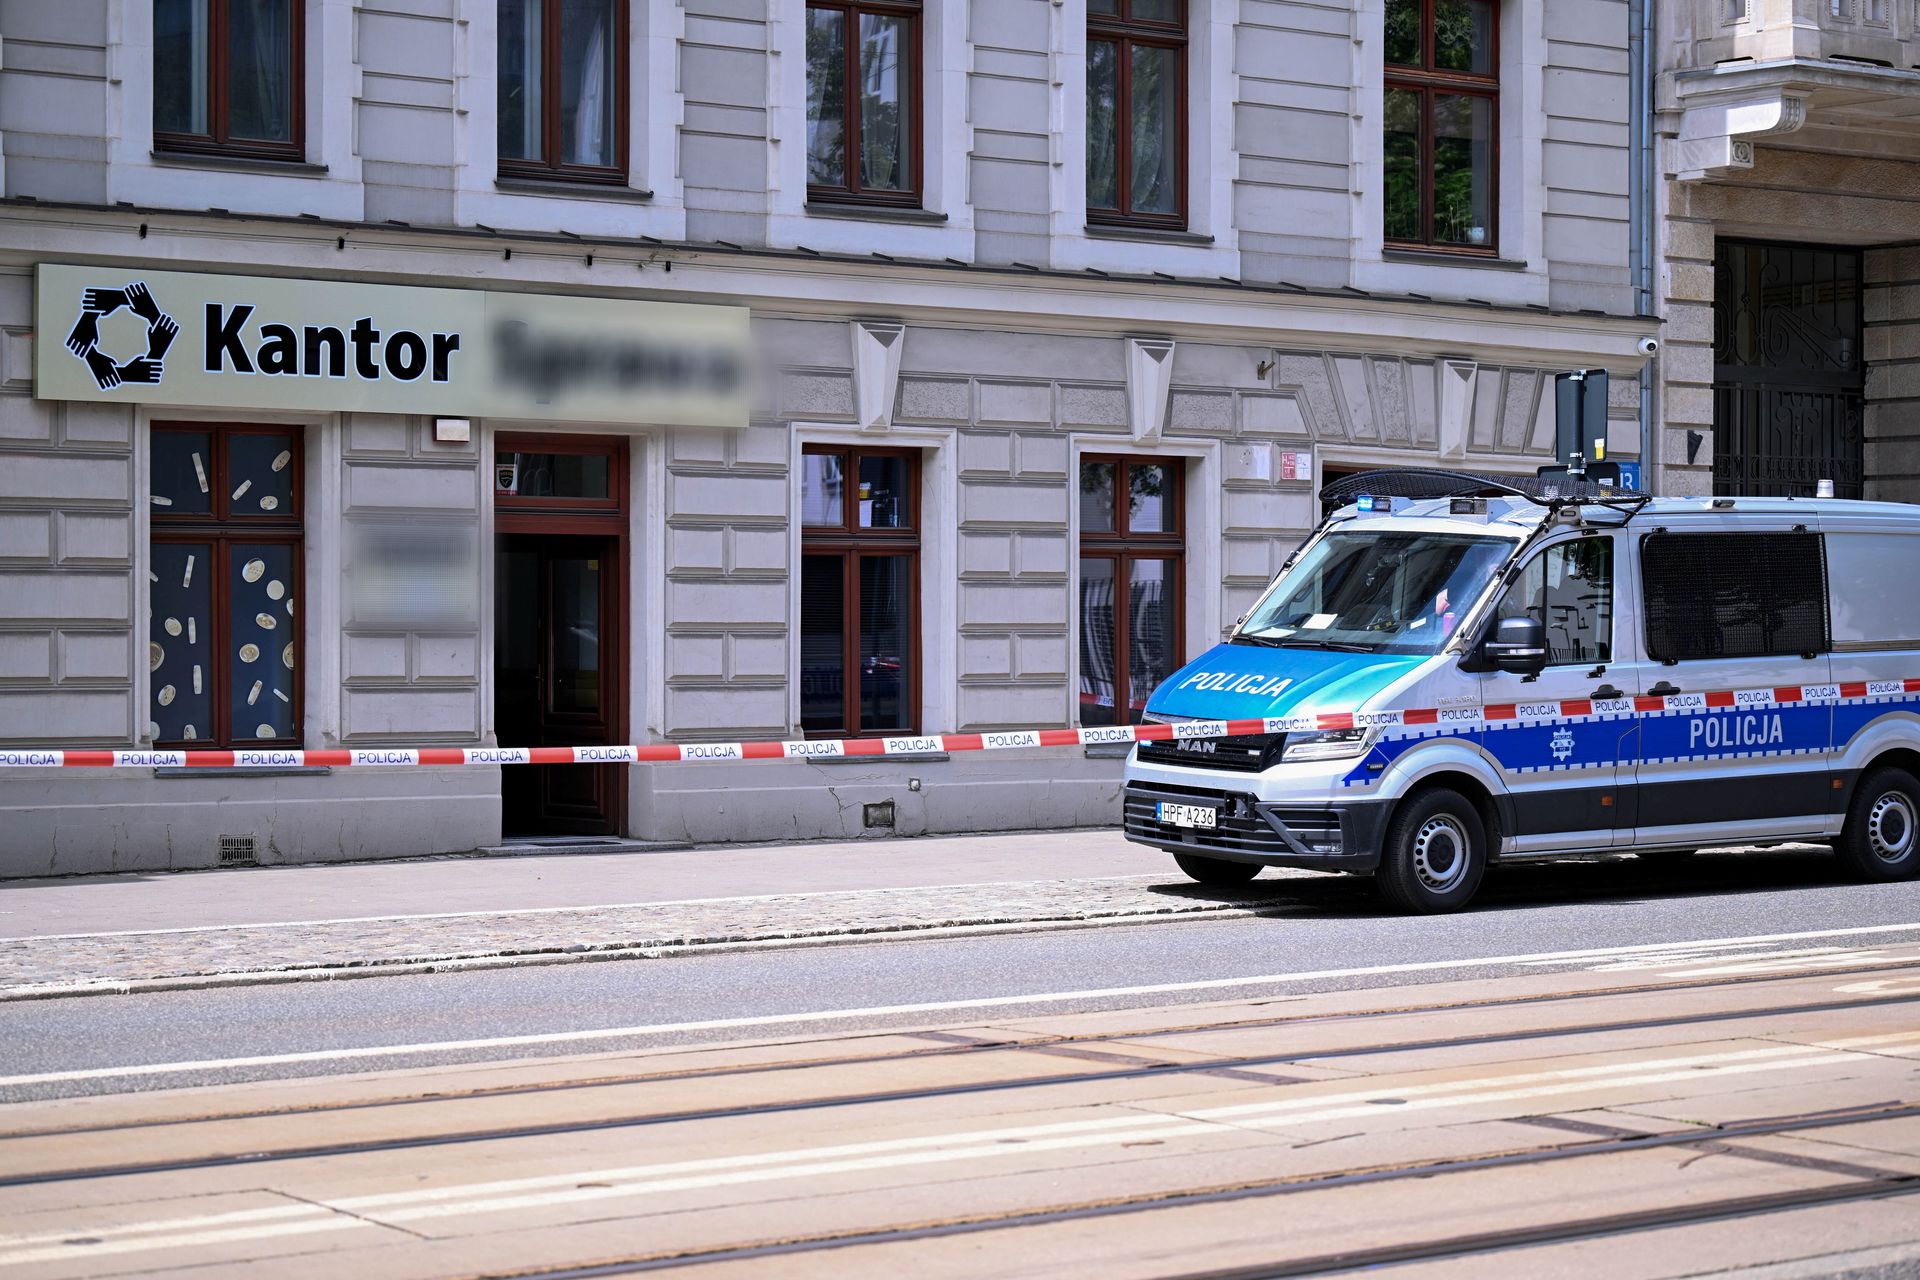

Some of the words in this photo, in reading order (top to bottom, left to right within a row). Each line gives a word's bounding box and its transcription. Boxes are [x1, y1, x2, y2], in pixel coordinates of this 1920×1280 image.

[204, 302, 461, 383] Kantor
[1179, 672, 1293, 697] POLICJA
[0, 754, 55, 765] POLICJA
[121, 754, 178, 765] POLICJA
[241, 753, 297, 764] POLICJA
[358, 752, 411, 764] POLICJA
[471, 751, 523, 762] POLICJA
[580, 749, 631, 760] POLICJA
[687, 746, 736, 758] POLICJA
[789, 743, 837, 755] POLICJA
[889, 739, 937, 751] POLICJA
[988, 734, 1034, 747] POLICJA
[1084, 729, 1129, 742] POLICJA
[1178, 724, 1221, 736] POLICJA
[1358, 713, 1399, 725] POLICJA
[1441, 708, 1480, 720] POLICJA
[1520, 704, 1557, 716] POLICJA
[1595, 699, 1631, 712] POLICJA
[1667, 695, 1703, 708] POLICJA
[1737, 691, 1771, 703] POLICJA
[1804, 686, 1837, 698] POLICJA
[1869, 682, 1901, 693] POLICJA
[1690, 714, 1783, 749] POLICJA
[1177, 739, 1216, 753] MAN
[1163, 804, 1183, 822] HPF
[1186, 806, 1214, 825] A236
